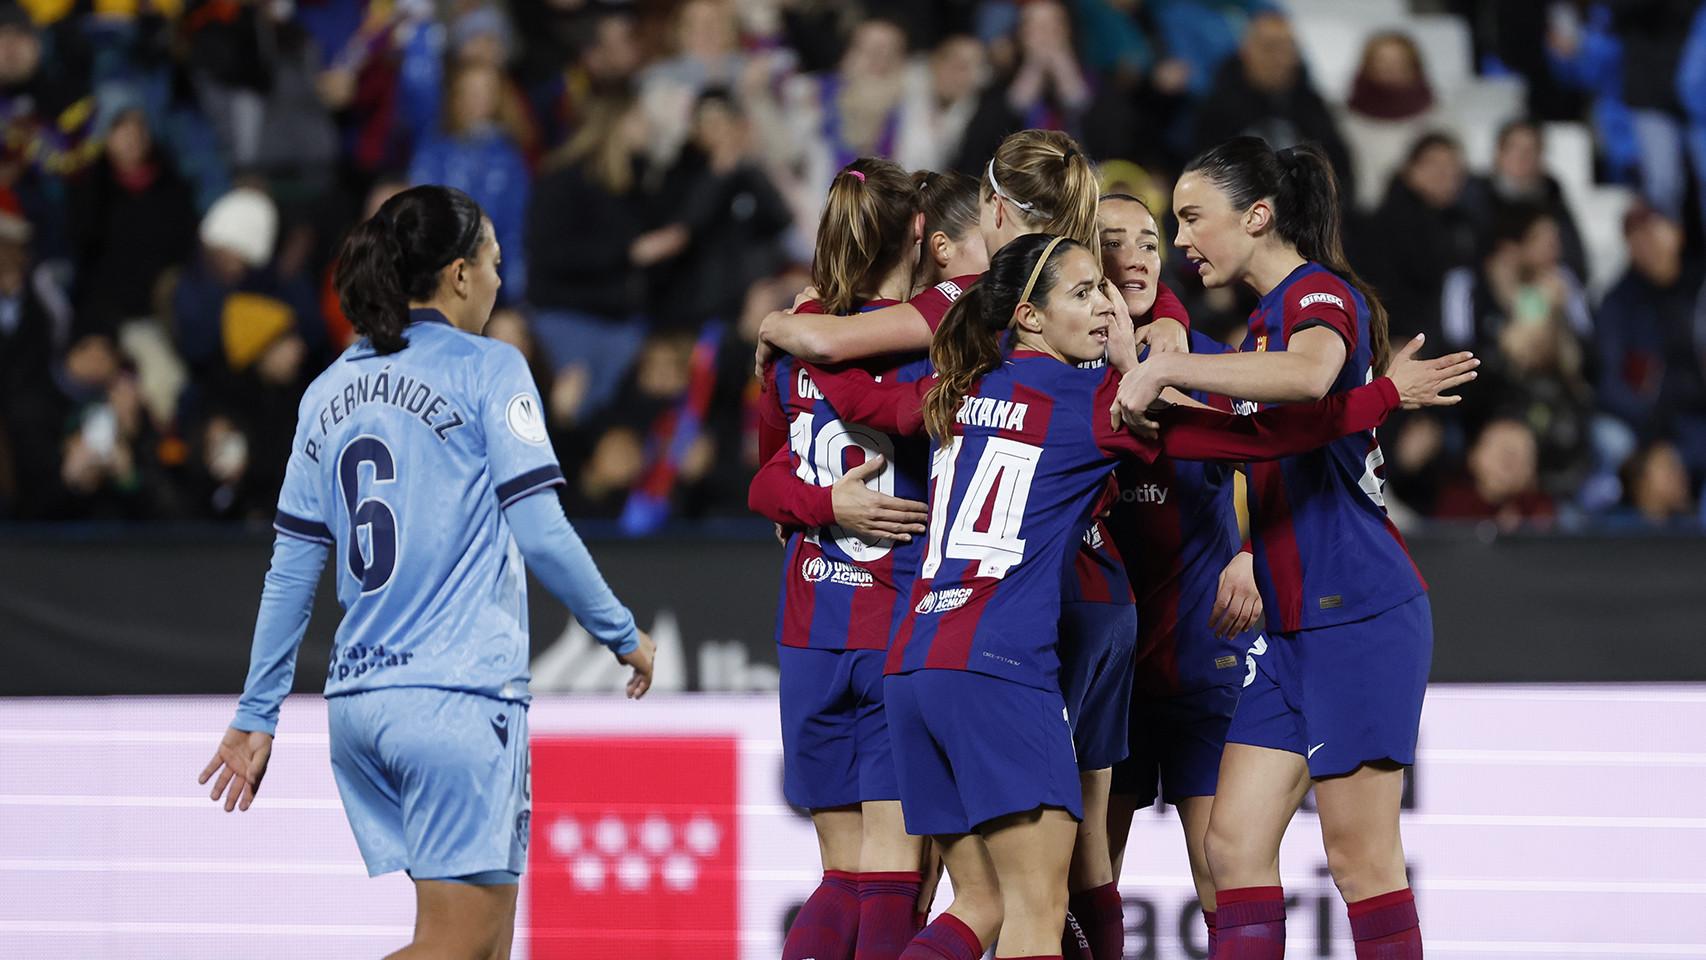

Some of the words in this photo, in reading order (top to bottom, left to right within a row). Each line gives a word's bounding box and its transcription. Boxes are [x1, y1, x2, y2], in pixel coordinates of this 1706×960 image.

[1299, 293, 1345, 309] BIMBO
[305, 437, 322, 464] P.
[319, 364, 464, 441] FERNÁNDEZ
[956, 395, 1029, 431] AITANA
[1121, 483, 1169, 505] otify
[338, 433, 398, 597] 6
[921, 435, 1044, 580] 14
[830, 571, 874, 583] ACNUR
[935, 597, 969, 610] ACNUR
[939, 588, 974, 600] UNHCR
